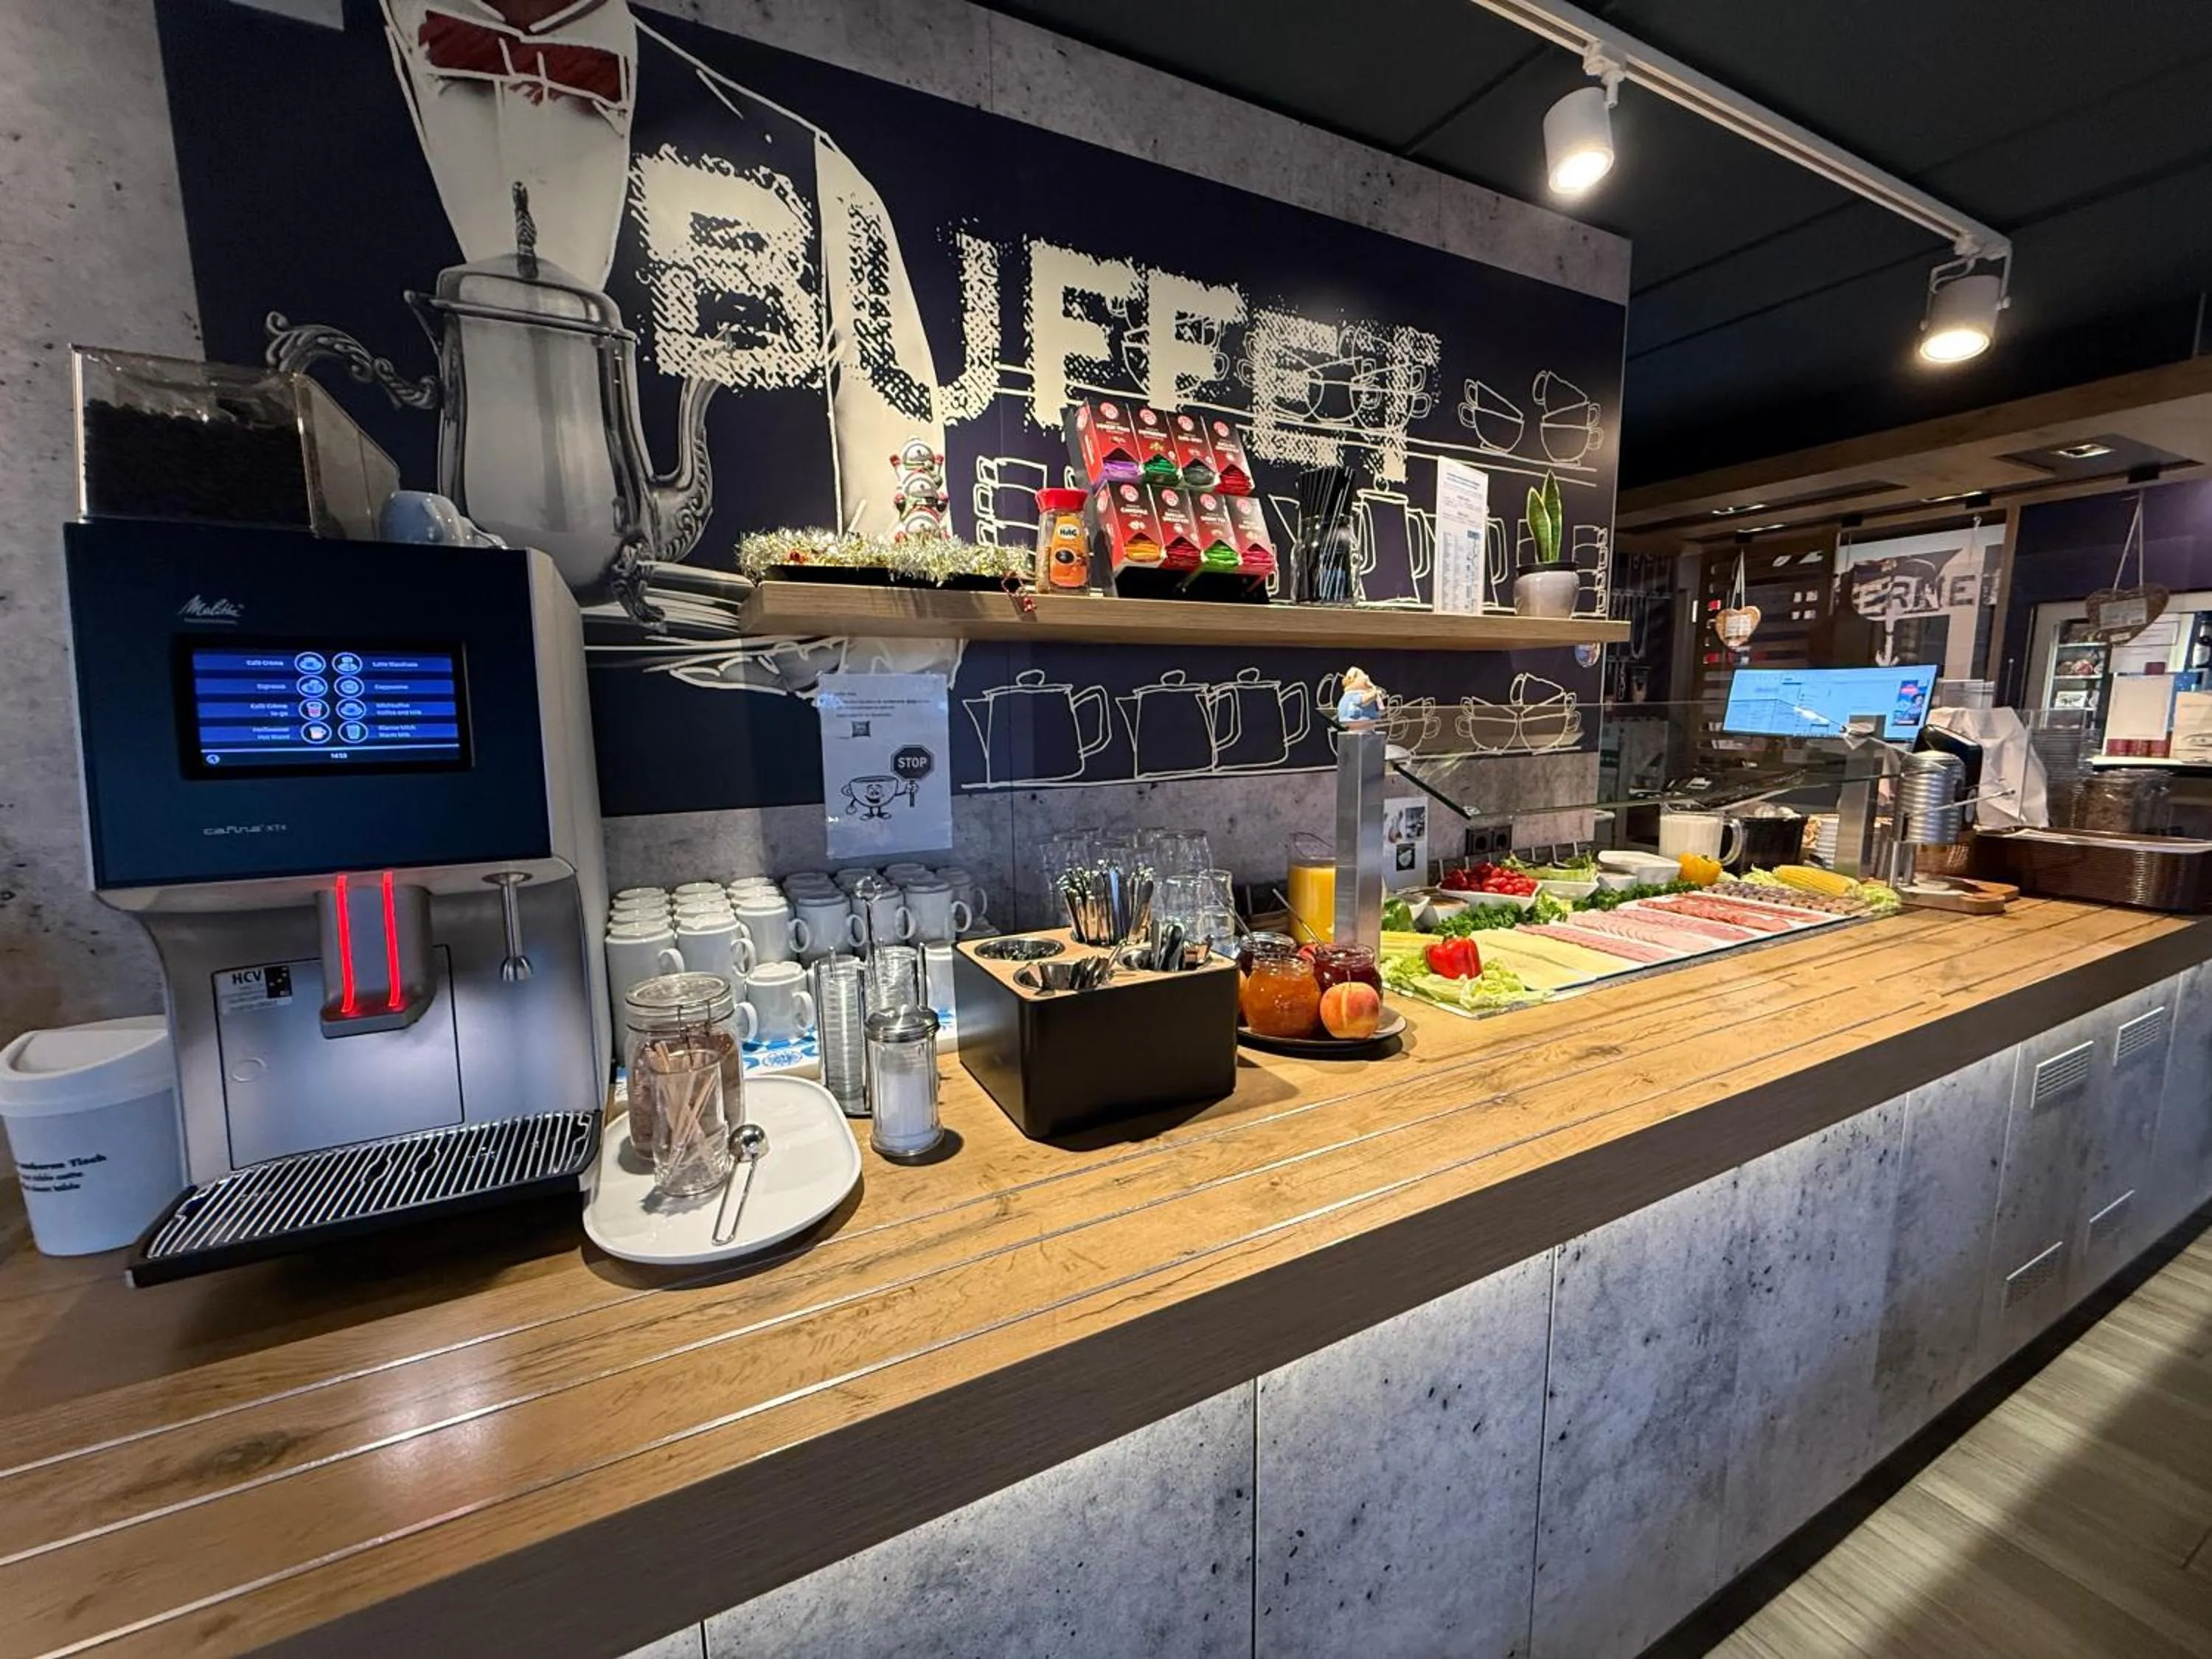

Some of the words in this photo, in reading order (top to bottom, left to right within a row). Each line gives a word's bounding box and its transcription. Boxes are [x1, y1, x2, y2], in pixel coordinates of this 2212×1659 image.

[629, 142, 1441, 483] BUFFET
[897, 757, 927, 768] STOP
[232, 970, 262, 985] HCV
